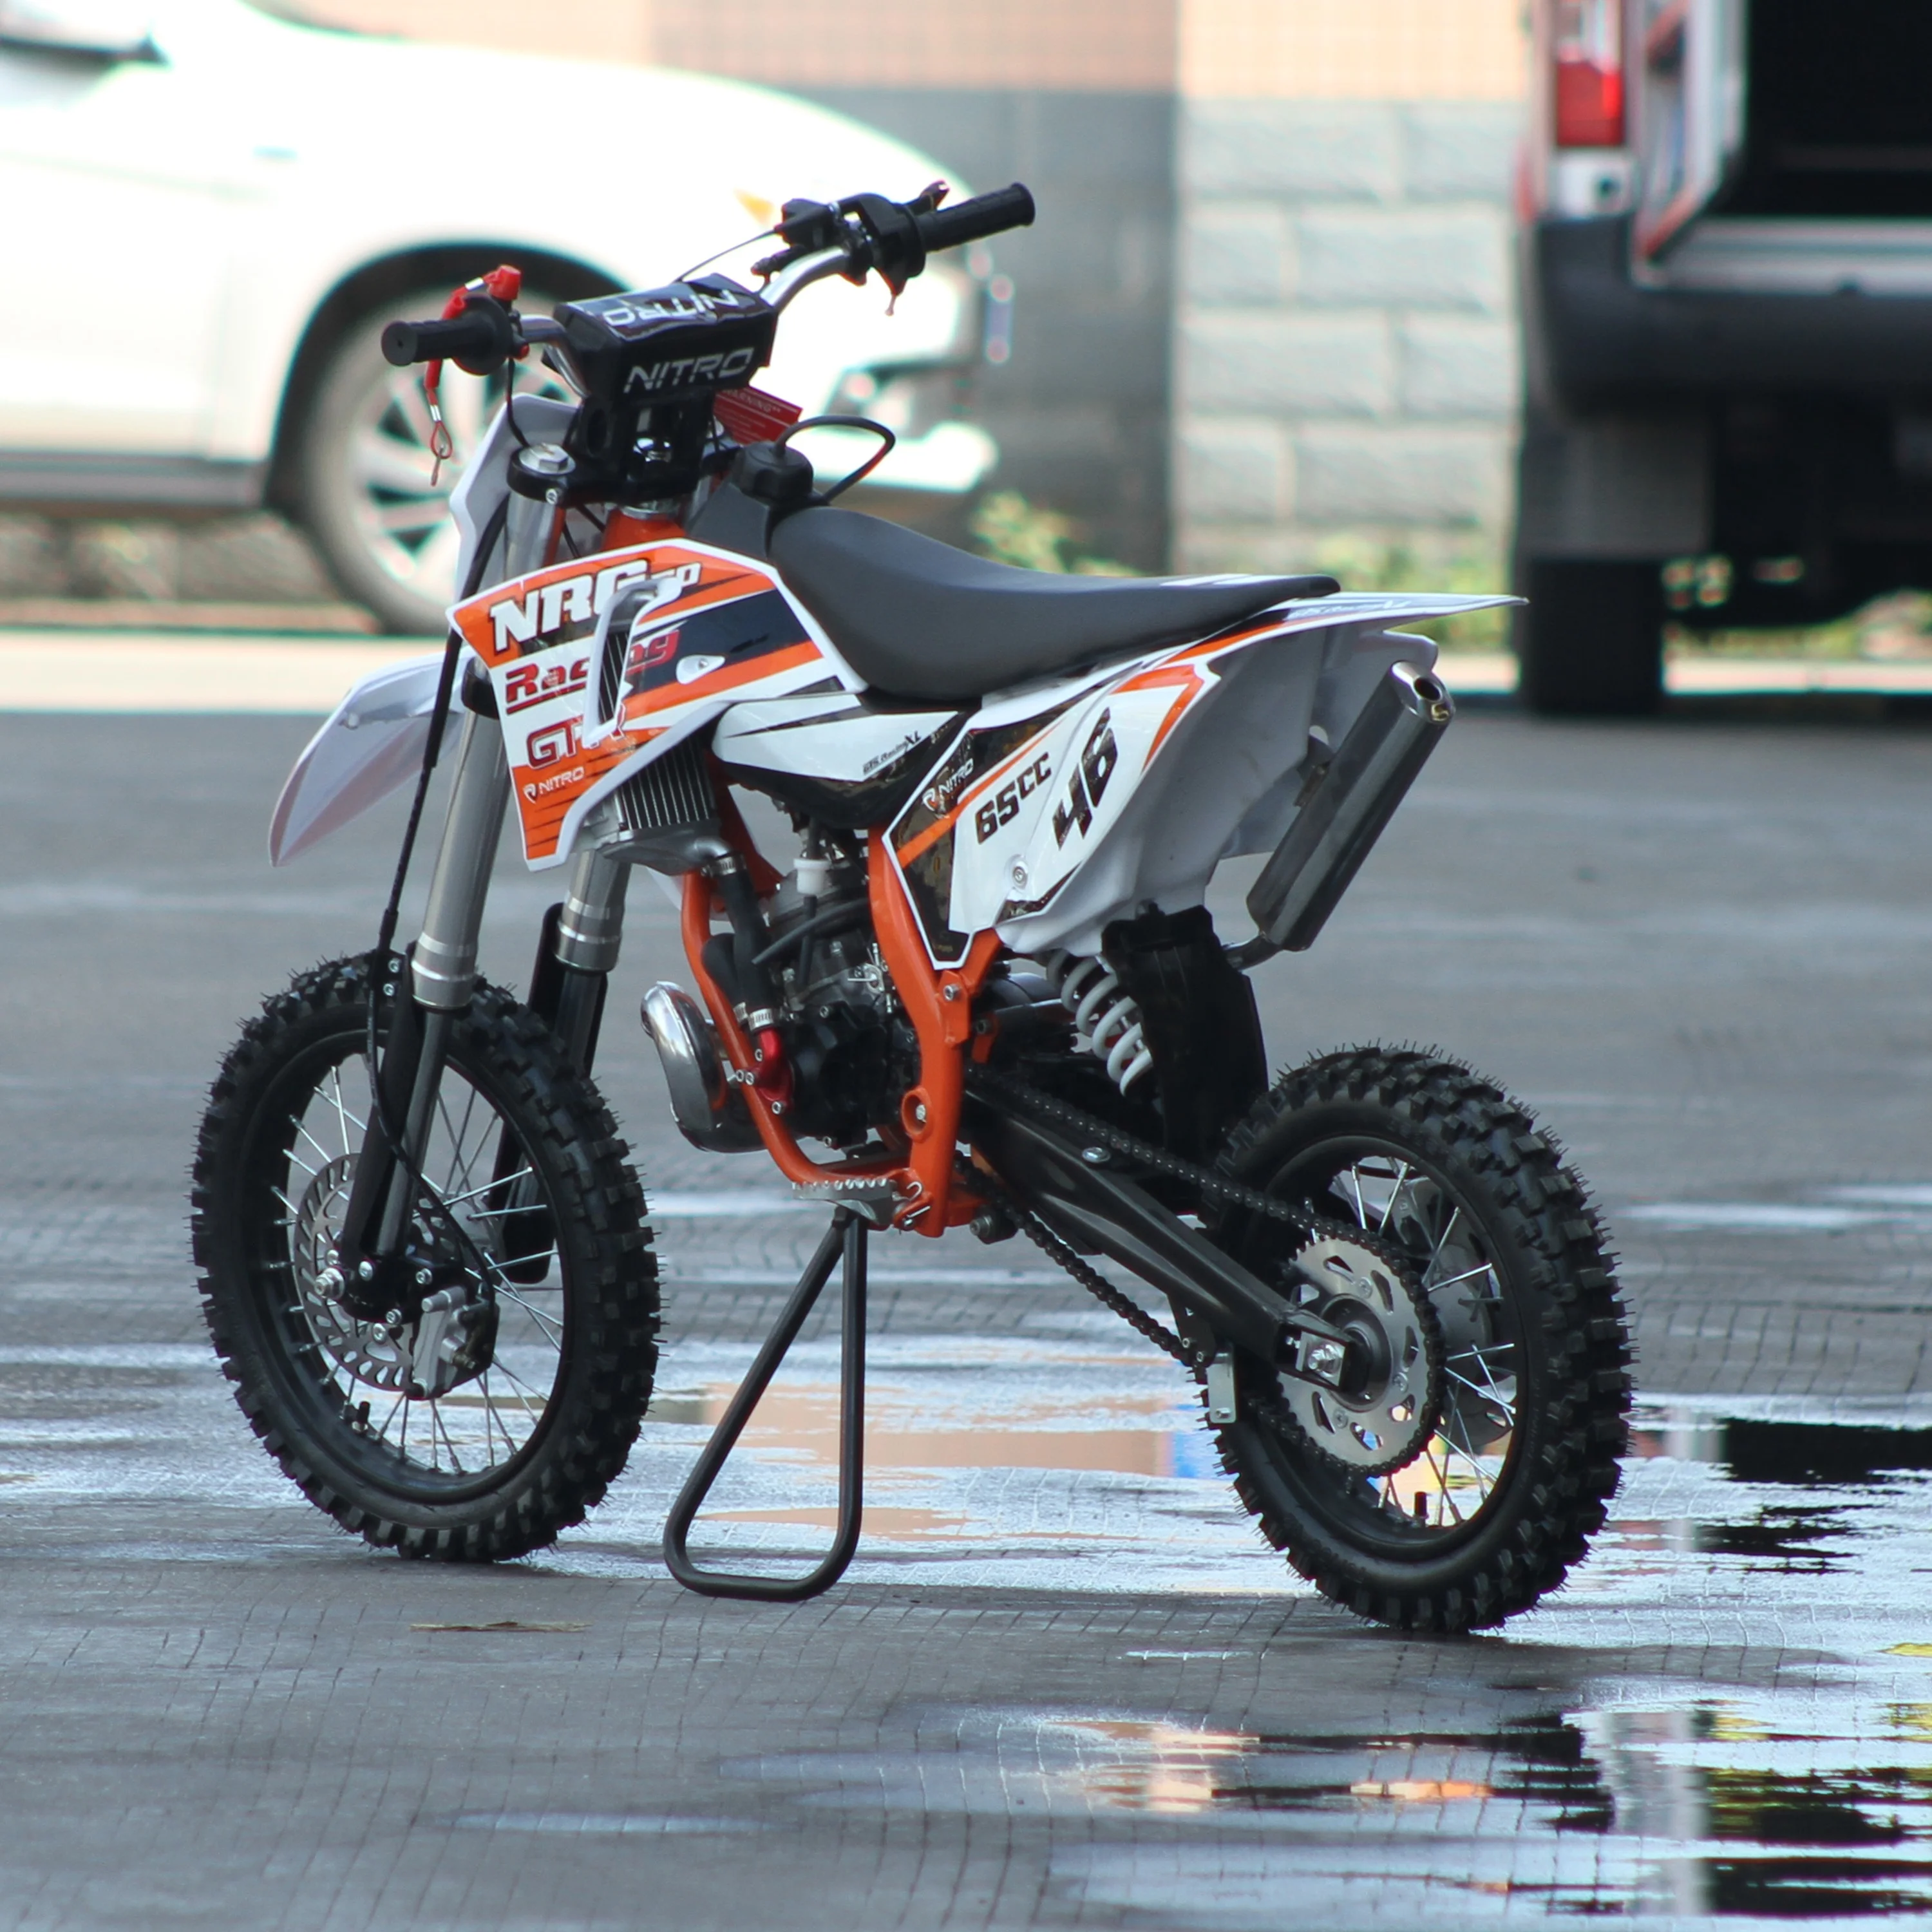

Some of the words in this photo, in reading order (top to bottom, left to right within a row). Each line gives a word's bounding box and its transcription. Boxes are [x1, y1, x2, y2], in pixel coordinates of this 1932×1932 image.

[602, 289, 740, 327] NITRO
[623, 347, 755, 393] NITRO
[506, 629, 681, 705] Racng
[526, 702, 625, 770] GT
[538, 766, 585, 795] NITRO
[938, 758, 974, 799] NITRO
[975, 751, 1052, 846] 65CC
[1052, 706, 1119, 852] 46
